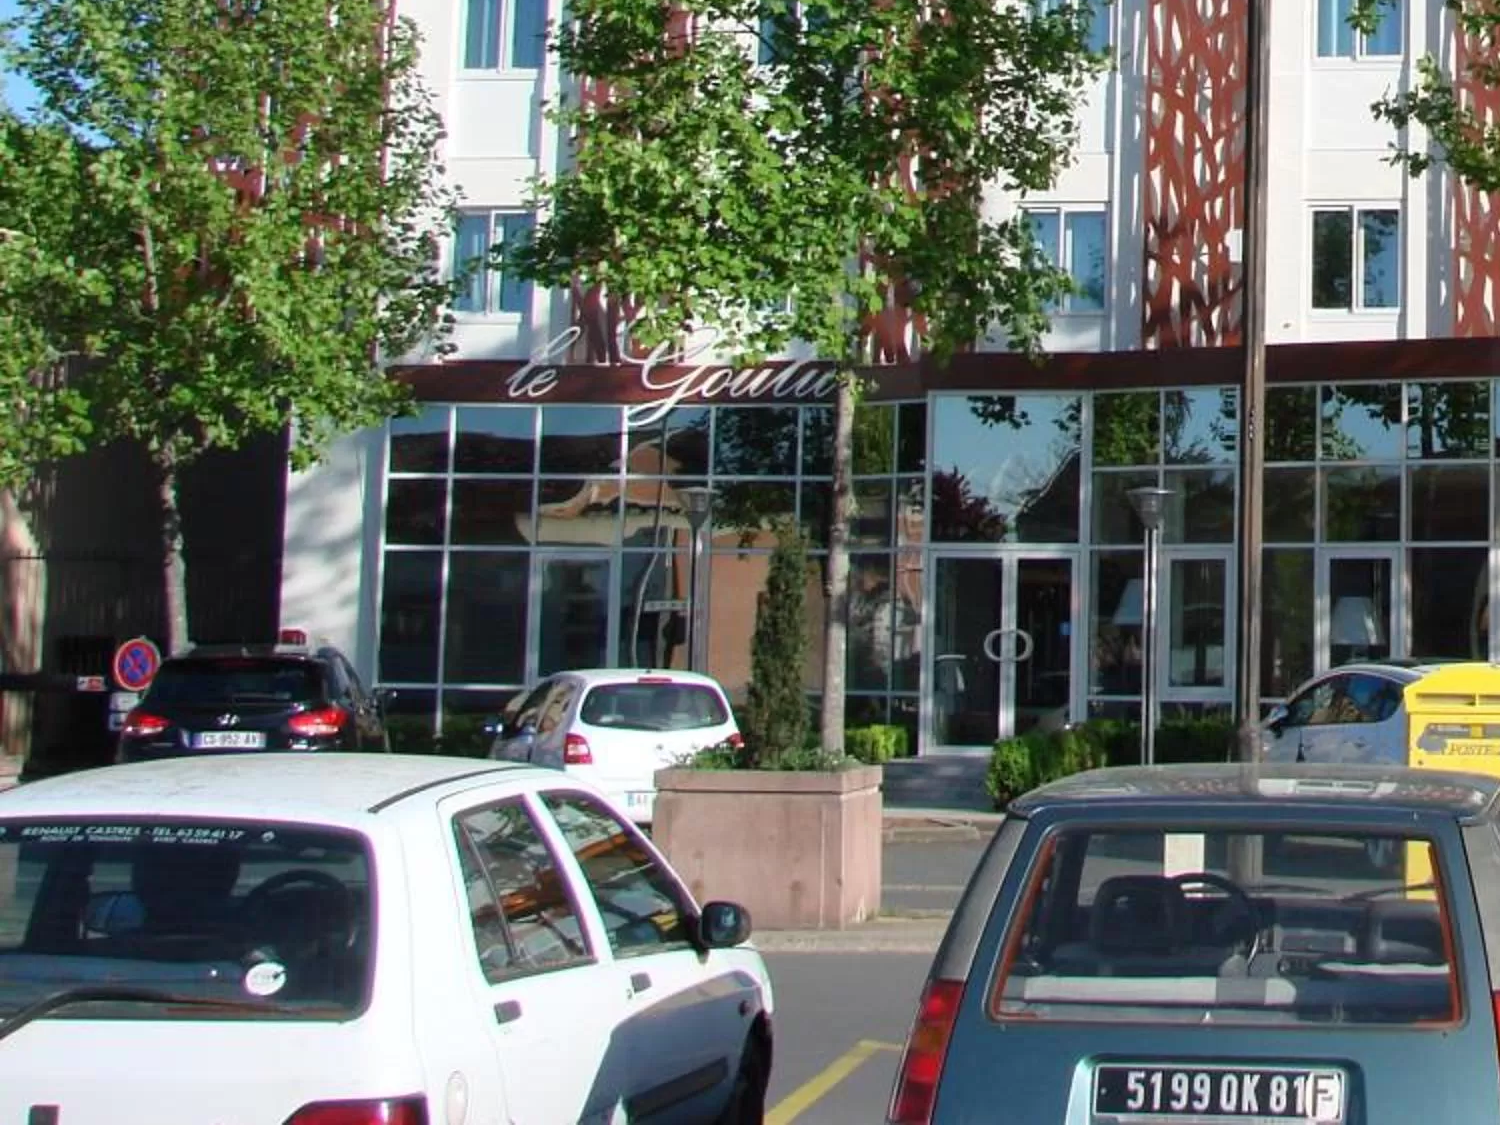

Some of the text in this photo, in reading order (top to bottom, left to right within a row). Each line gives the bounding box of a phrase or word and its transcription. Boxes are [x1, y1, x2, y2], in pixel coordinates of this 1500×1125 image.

[506, 326, 581, 398] le
[1448, 743, 1496, 756] POSTE
[21, 826, 81, 836] RENAULT
[85, 826, 141, 836] CASTRES
[1127, 1070, 1212, 1111] 5199
[1268, 1076, 1306, 1114] 81
